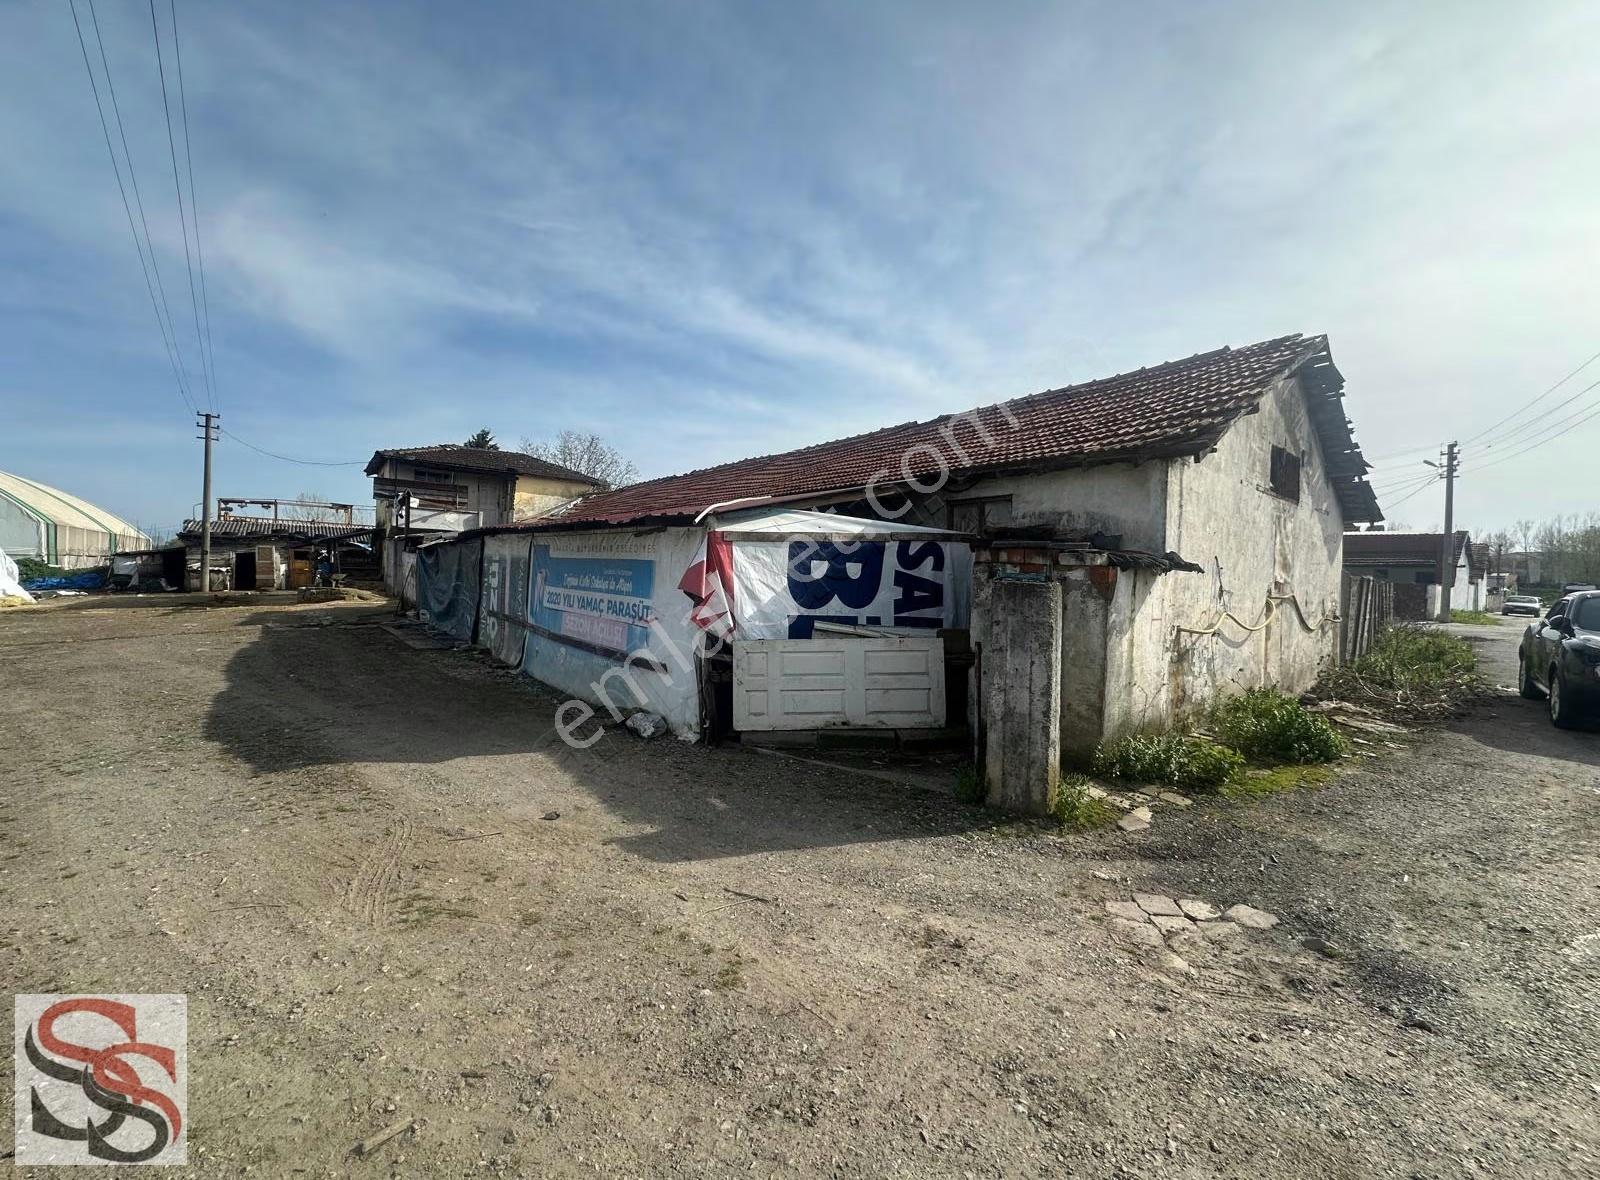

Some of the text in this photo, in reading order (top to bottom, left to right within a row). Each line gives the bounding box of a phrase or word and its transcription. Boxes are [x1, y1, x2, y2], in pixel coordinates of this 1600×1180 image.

[546, 590, 561, 605] 2020
[562, 592, 575, 608] YILI
[576, 595, 604, 617] YAMAÇ
